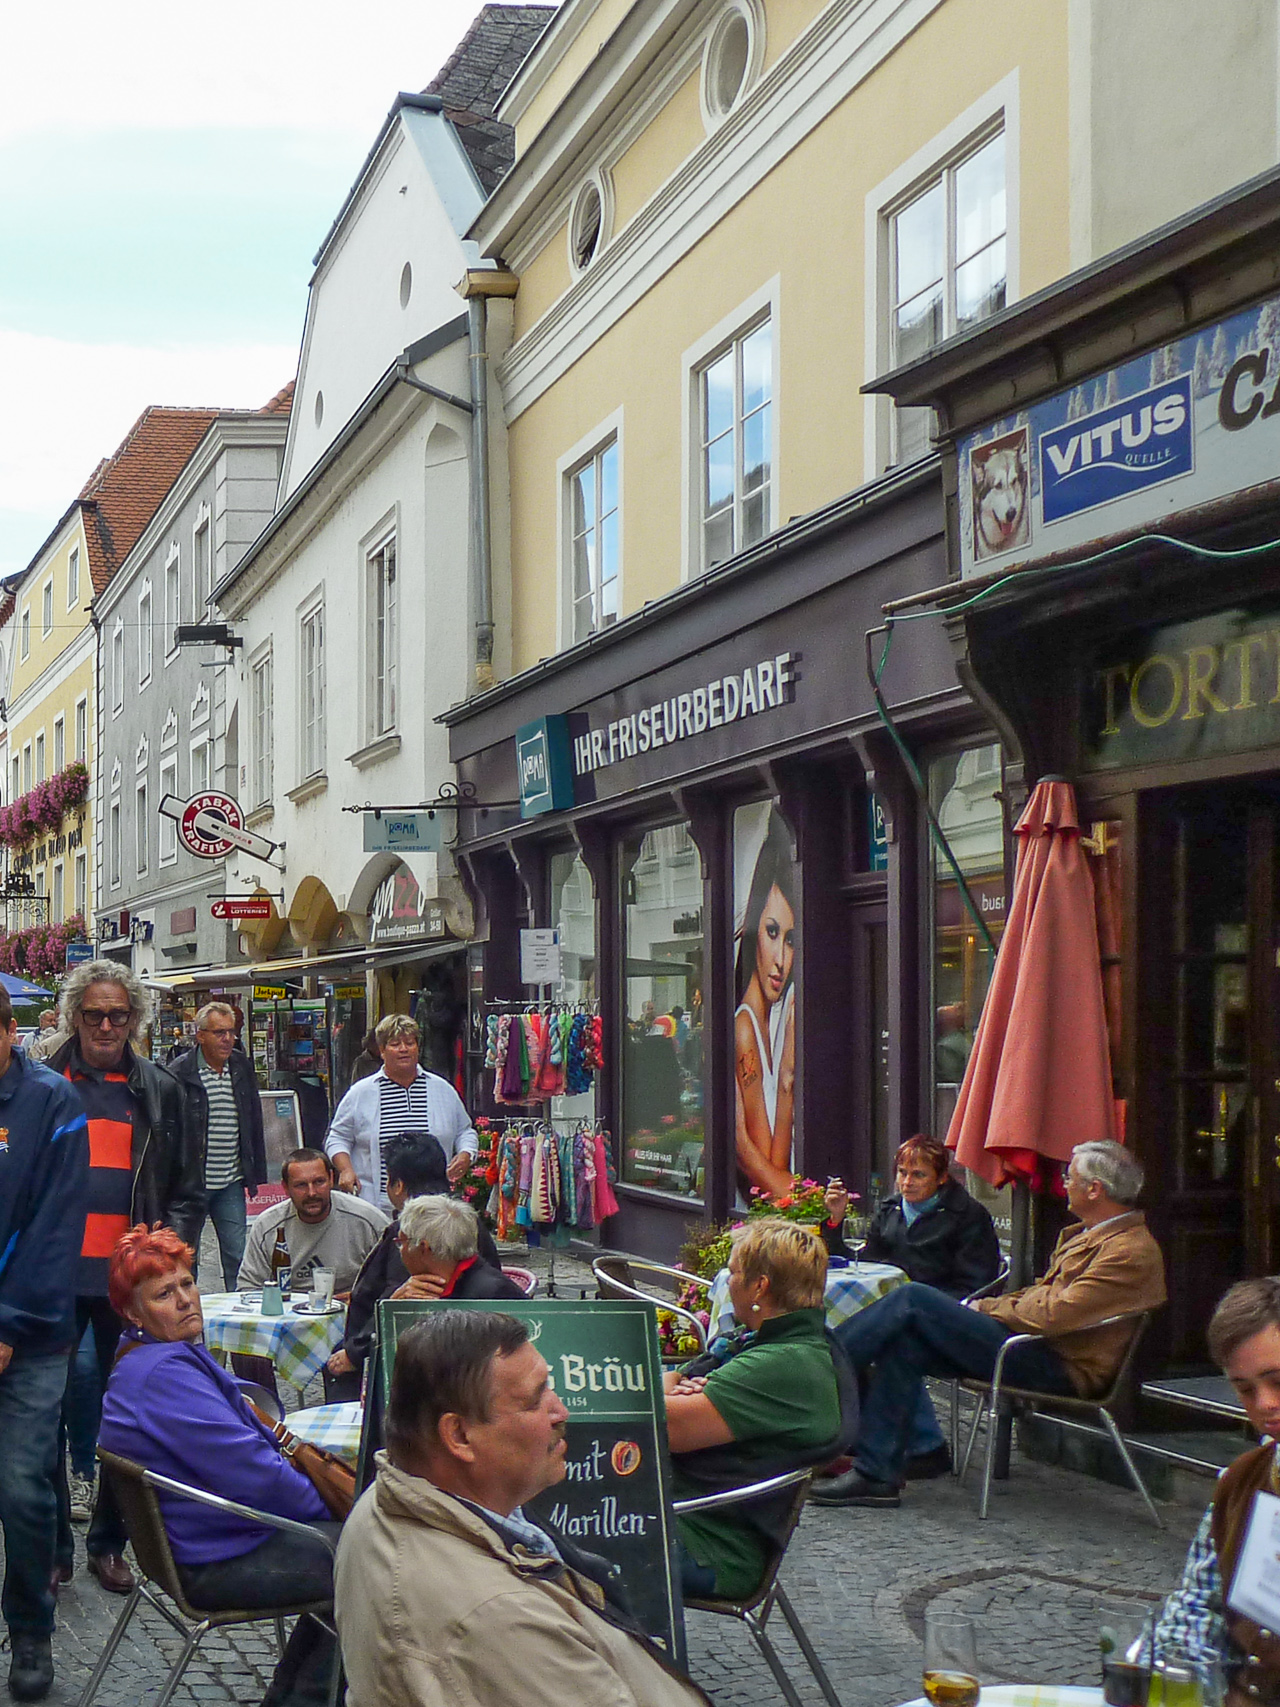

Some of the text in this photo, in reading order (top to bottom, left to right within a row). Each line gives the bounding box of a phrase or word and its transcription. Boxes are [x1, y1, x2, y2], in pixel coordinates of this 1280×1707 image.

[1046, 393, 1186, 476] VITUS
[1124, 446, 1172, 466] QUELLE
[1096, 629, 1280, 736] TORT
[574, 651, 792, 776] IHR FRISEURBEDARF
[192, 797, 239, 824] TABAK
[183, 819, 227, 854] TRAFIK
[388, 823, 416, 836] ROMA
[560, 1353, 647, 1393] Bräu
[566, 1396, 588, 1407] 1454
[549, 1495, 658, 1538] Marillen-
